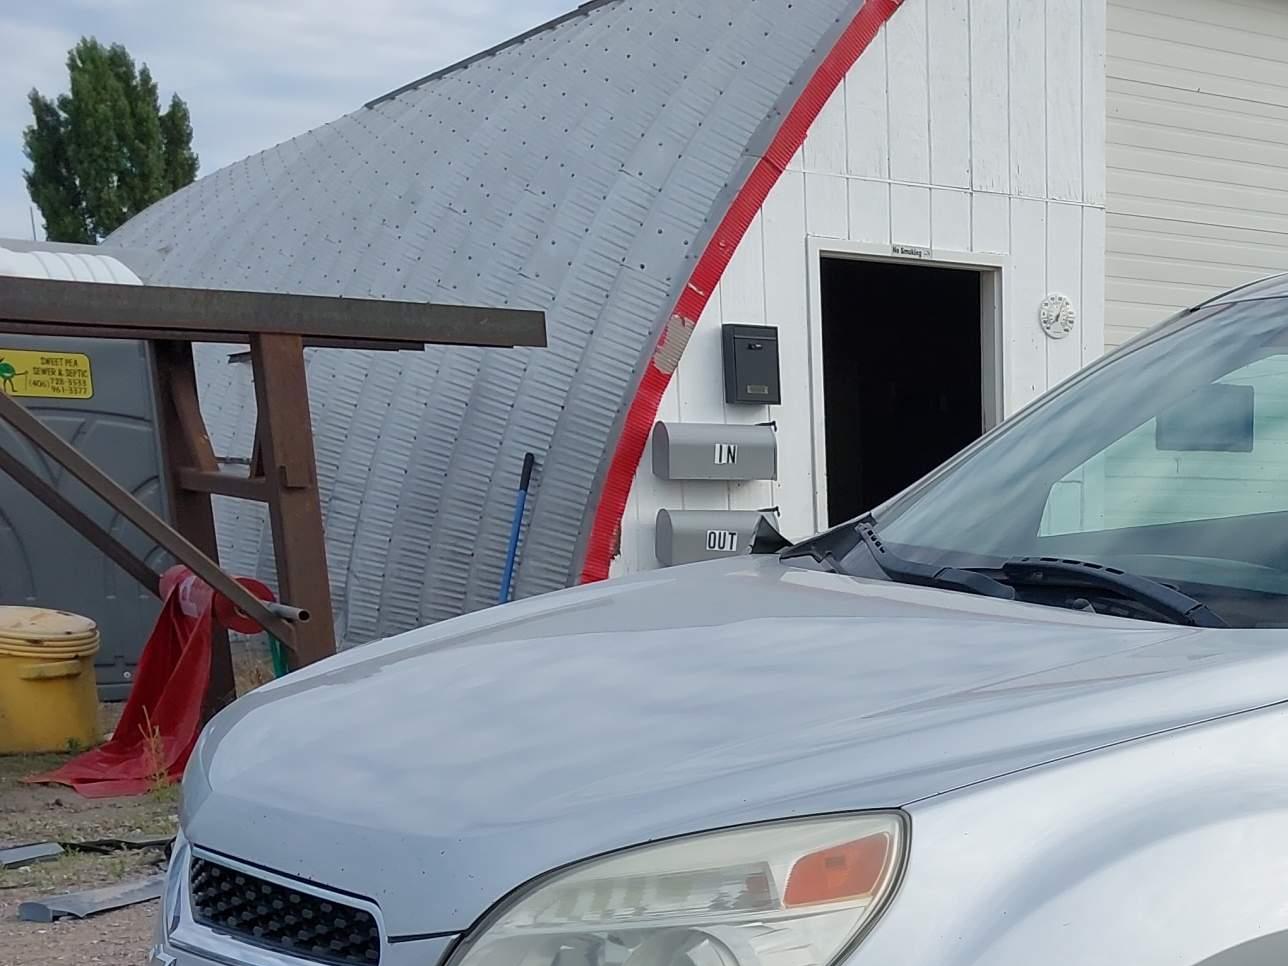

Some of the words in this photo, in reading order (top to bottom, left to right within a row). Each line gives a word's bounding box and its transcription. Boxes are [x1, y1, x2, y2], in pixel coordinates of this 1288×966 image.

[40, 356, 64, 367] SWEET
[65, 359, 79, 367] PEA
[33, 366, 56, 376] SEWER
[65, 369, 88, 378] SEPTIC
[719, 444, 736, 464] IN
[708, 531, 736, 550] OUT
